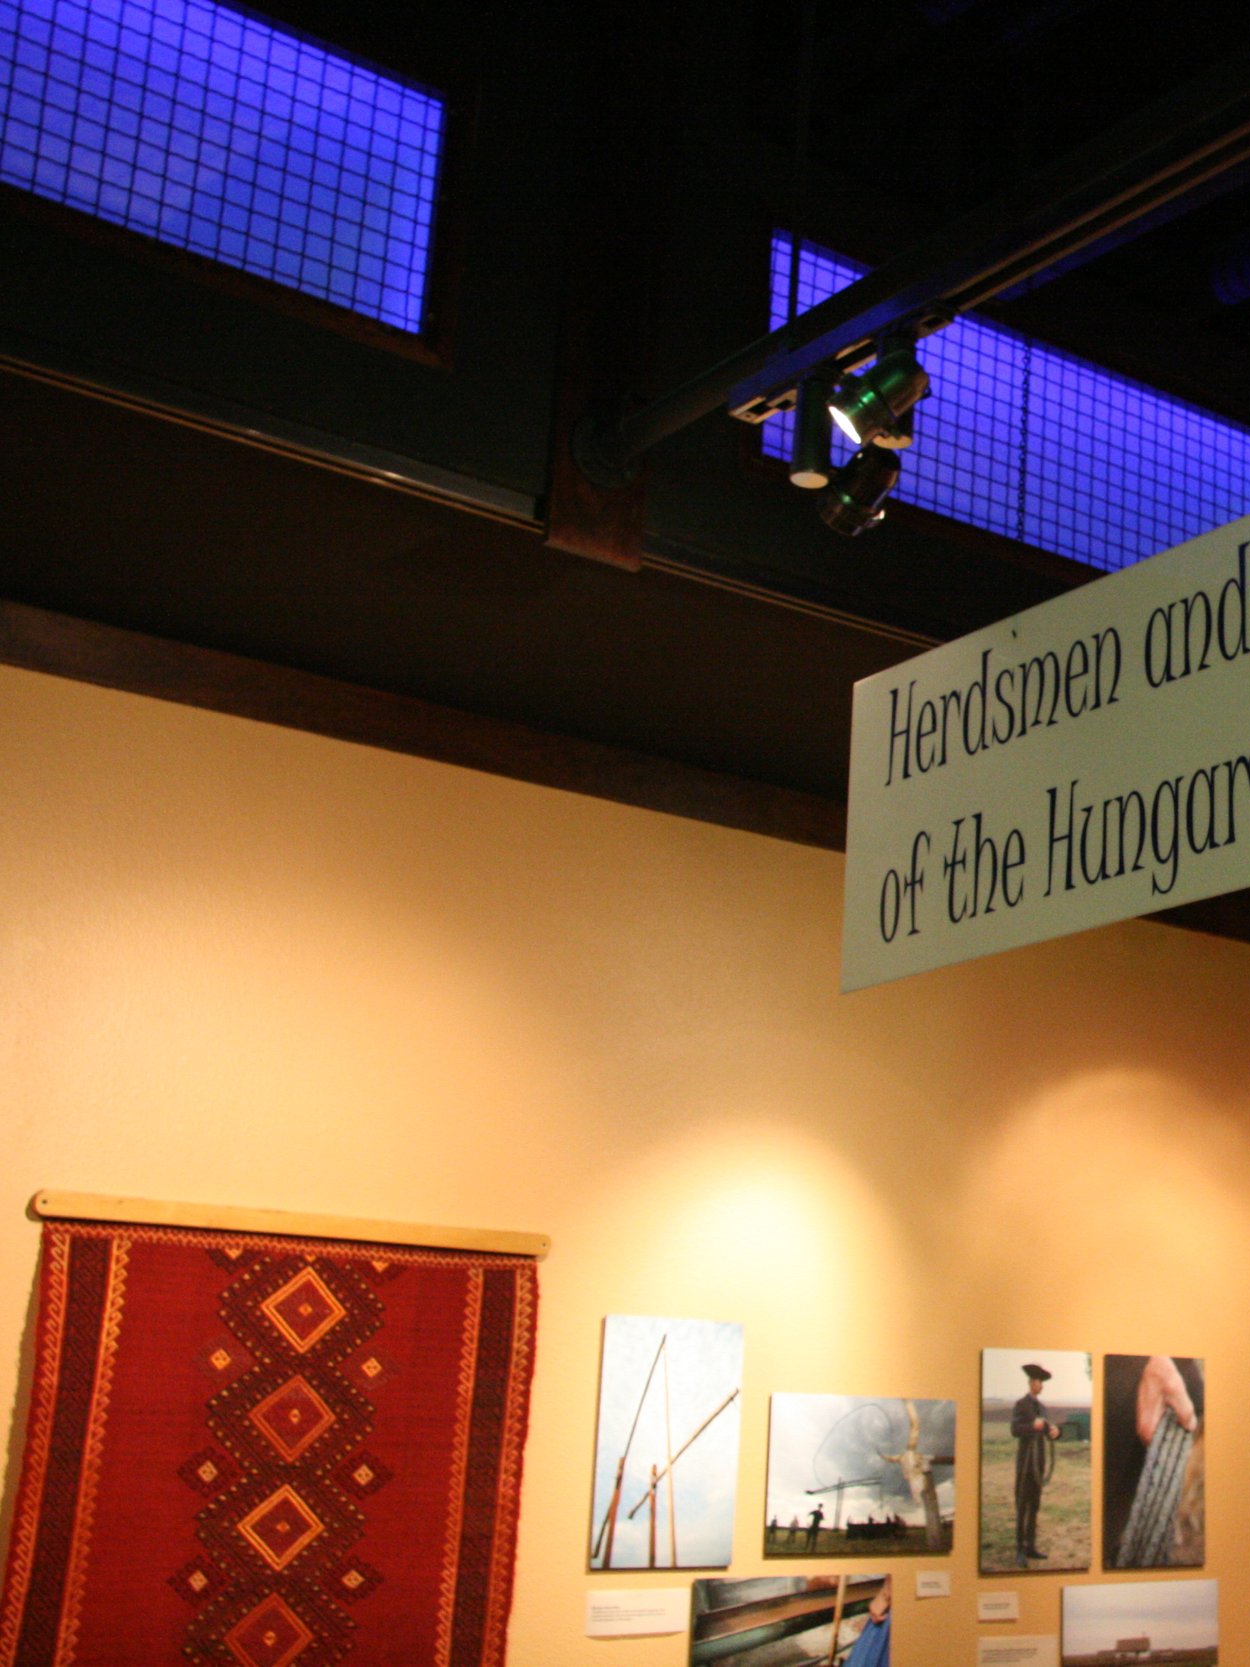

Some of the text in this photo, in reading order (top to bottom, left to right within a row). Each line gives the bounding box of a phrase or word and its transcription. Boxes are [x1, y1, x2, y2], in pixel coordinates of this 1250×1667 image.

[884, 626, 1122, 787] Herdsmen
[879, 830, 932, 944] of
[943, 811, 1027, 925] the
